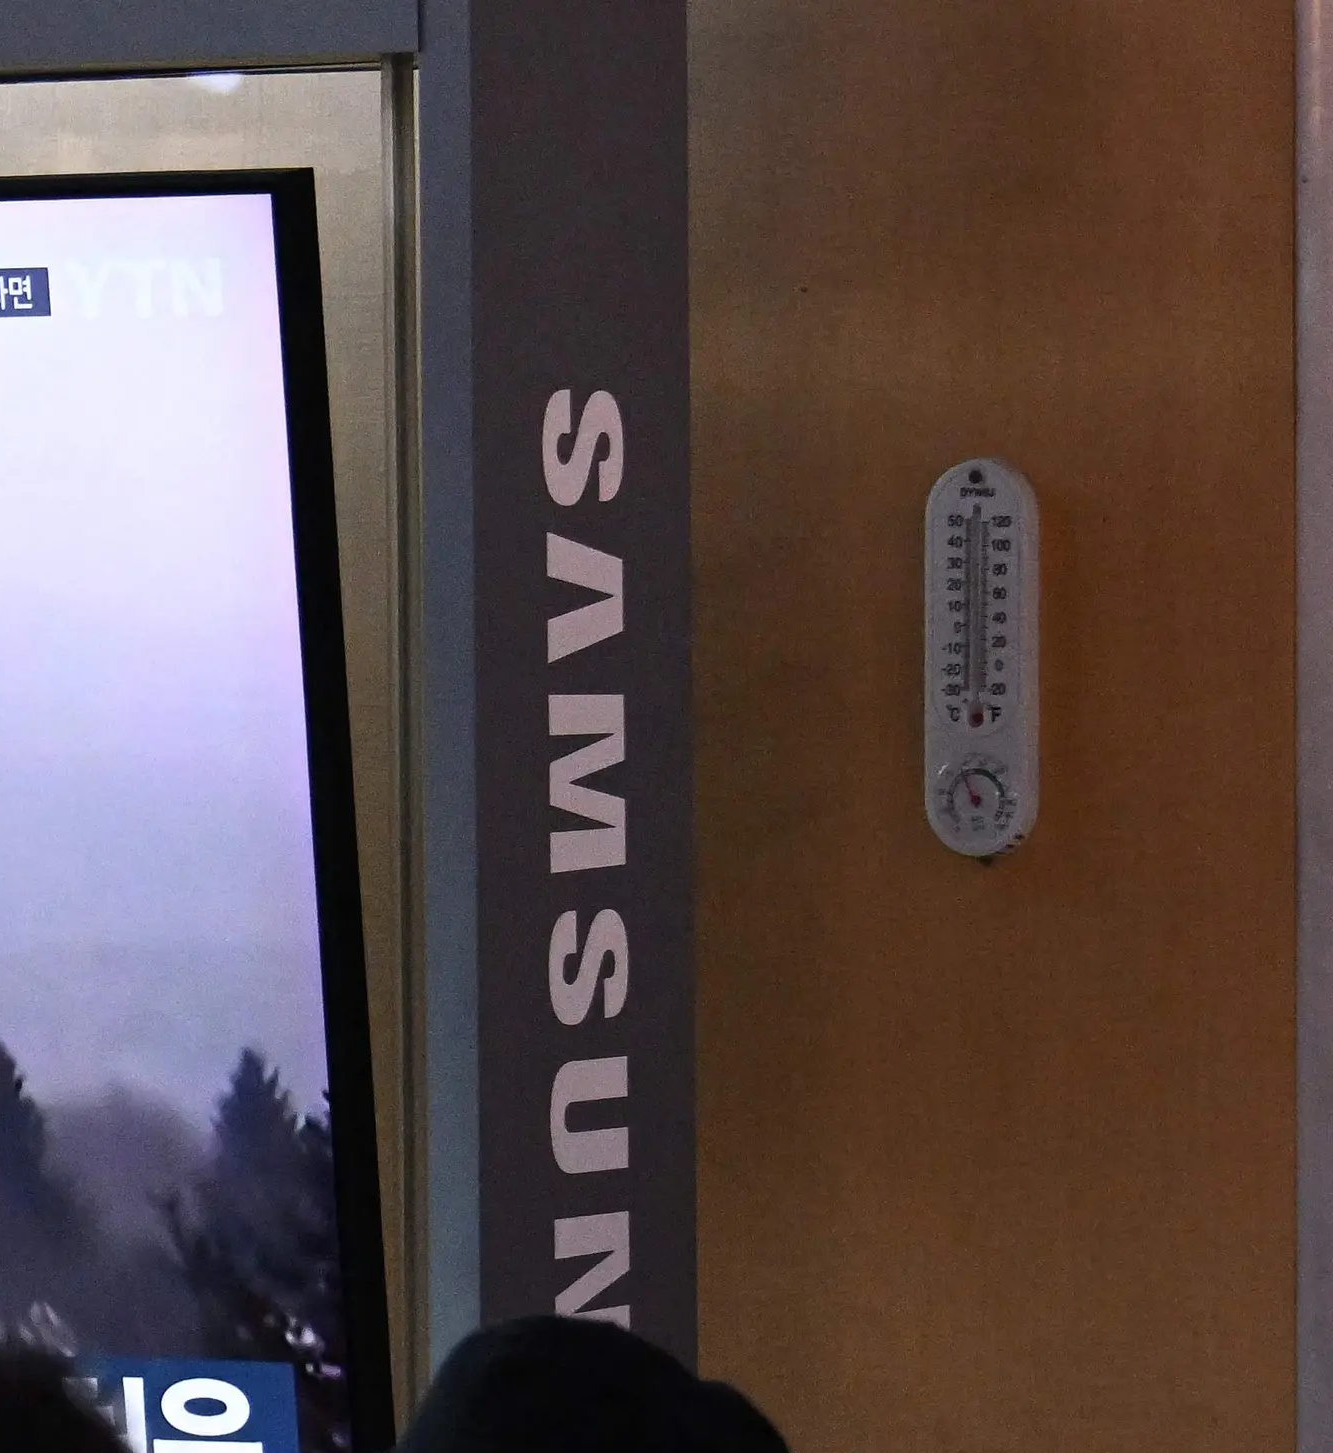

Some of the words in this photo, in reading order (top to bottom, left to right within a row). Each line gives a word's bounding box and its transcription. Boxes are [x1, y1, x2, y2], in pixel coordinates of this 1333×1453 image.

[64, 255, 224, 320] YTN
[947, 515, 964, 527] 50
[991, 515, 1013, 528] 120
[991, 539, 1012, 552] 100
[947, 556, 963, 569] 30
[542, 389, 631, 1331] SAMSUN
